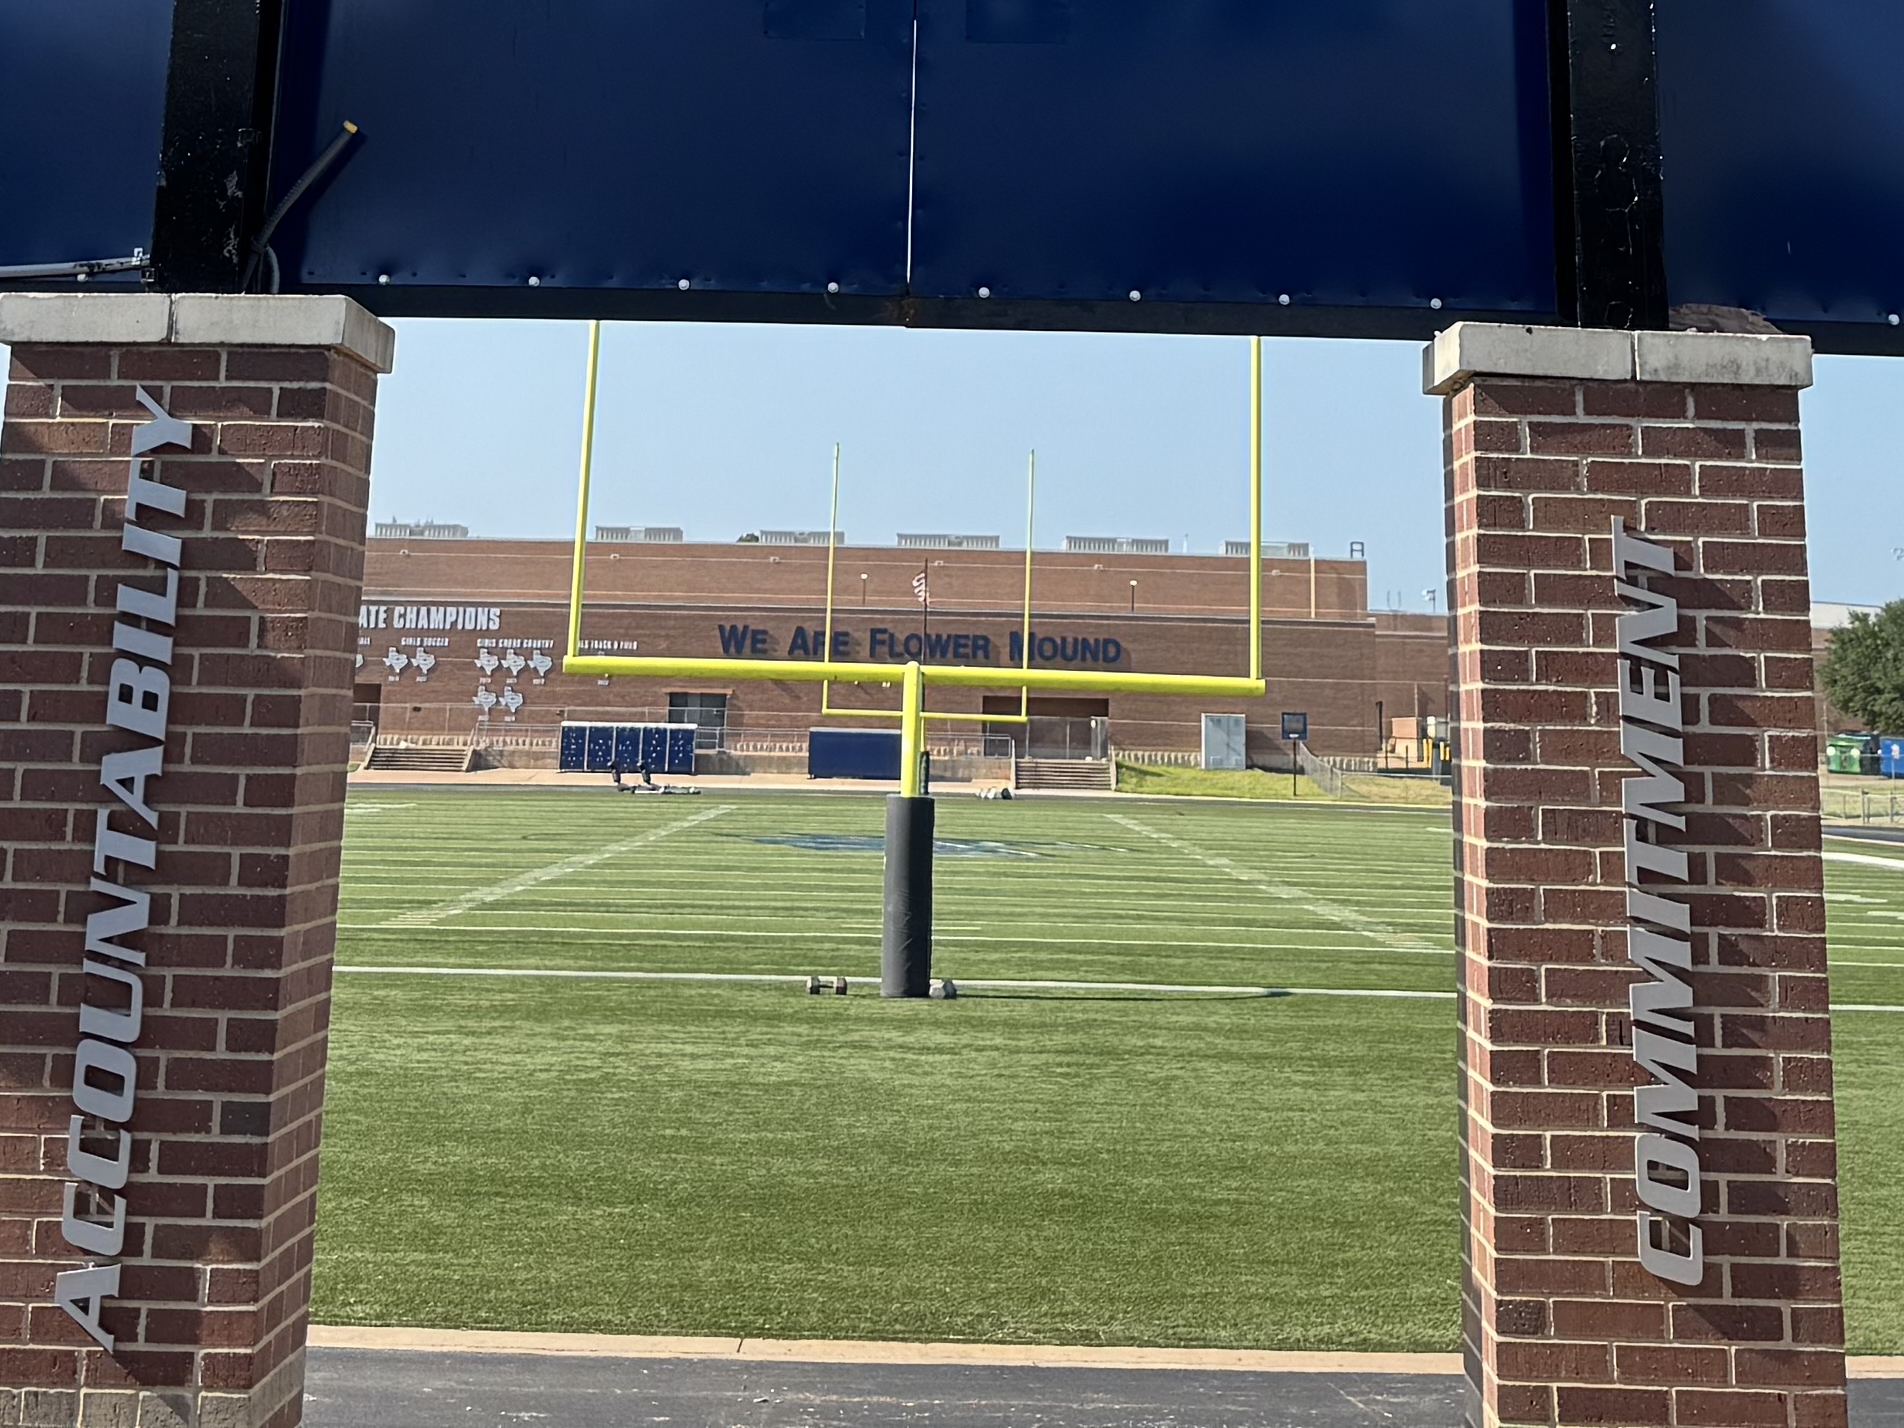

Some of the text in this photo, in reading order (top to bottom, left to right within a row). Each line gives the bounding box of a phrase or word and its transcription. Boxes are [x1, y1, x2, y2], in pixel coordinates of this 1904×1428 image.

[358, 605, 501, 630] ATE CHAMPIONS
[869, 628, 990, 660] FLOWER
[54, 384, 194, 1352] ACCOUNTABILITY
[1608, 515, 1706, 1287] COMMITMENT
